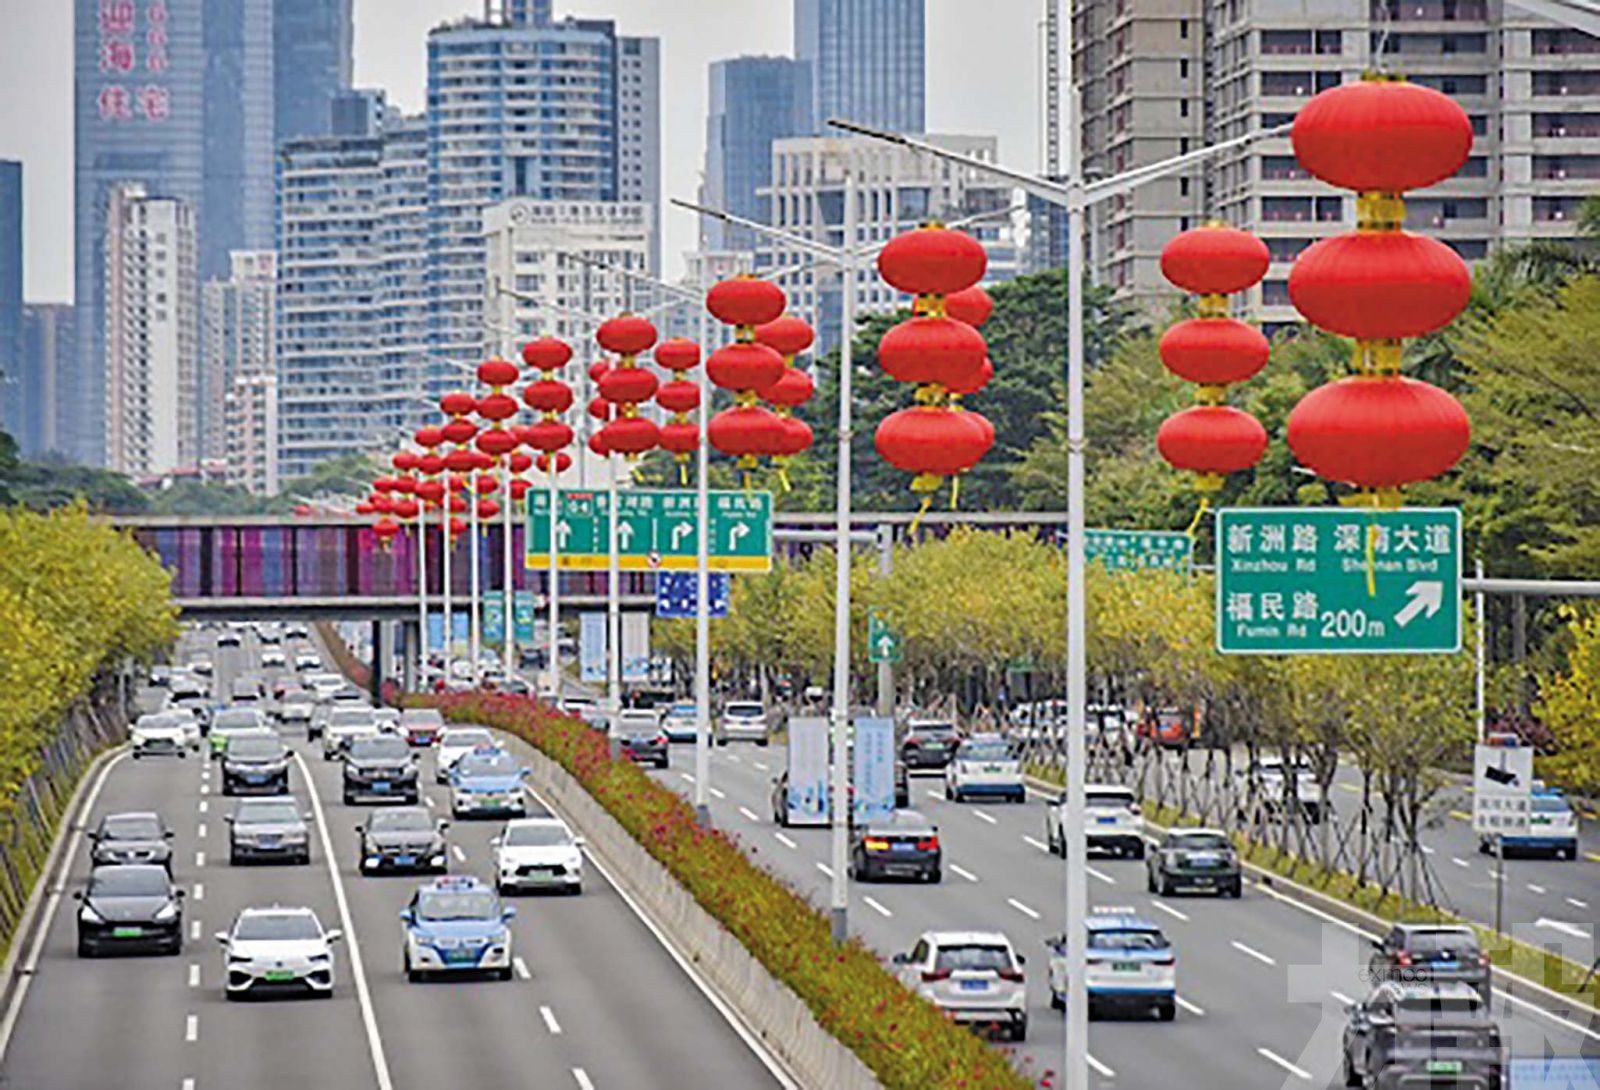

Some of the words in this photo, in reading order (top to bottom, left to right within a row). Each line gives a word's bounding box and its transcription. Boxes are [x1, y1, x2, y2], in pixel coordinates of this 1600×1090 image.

[1228, 524, 1317, 553] 新洲路
[1333, 524, 1450, 553] 深南大道
[1232, 559, 1287, 572] Xinzhou
[1296, 558, 1316, 572] Rd
[1406, 558, 1438, 572] Blvd
[1227, 591, 1318, 621] 福民路
[1237, 623, 1280, 637] Fumin
[1287, 623, 1307, 637] Rd
[1320, 609, 1385, 637] 200m
